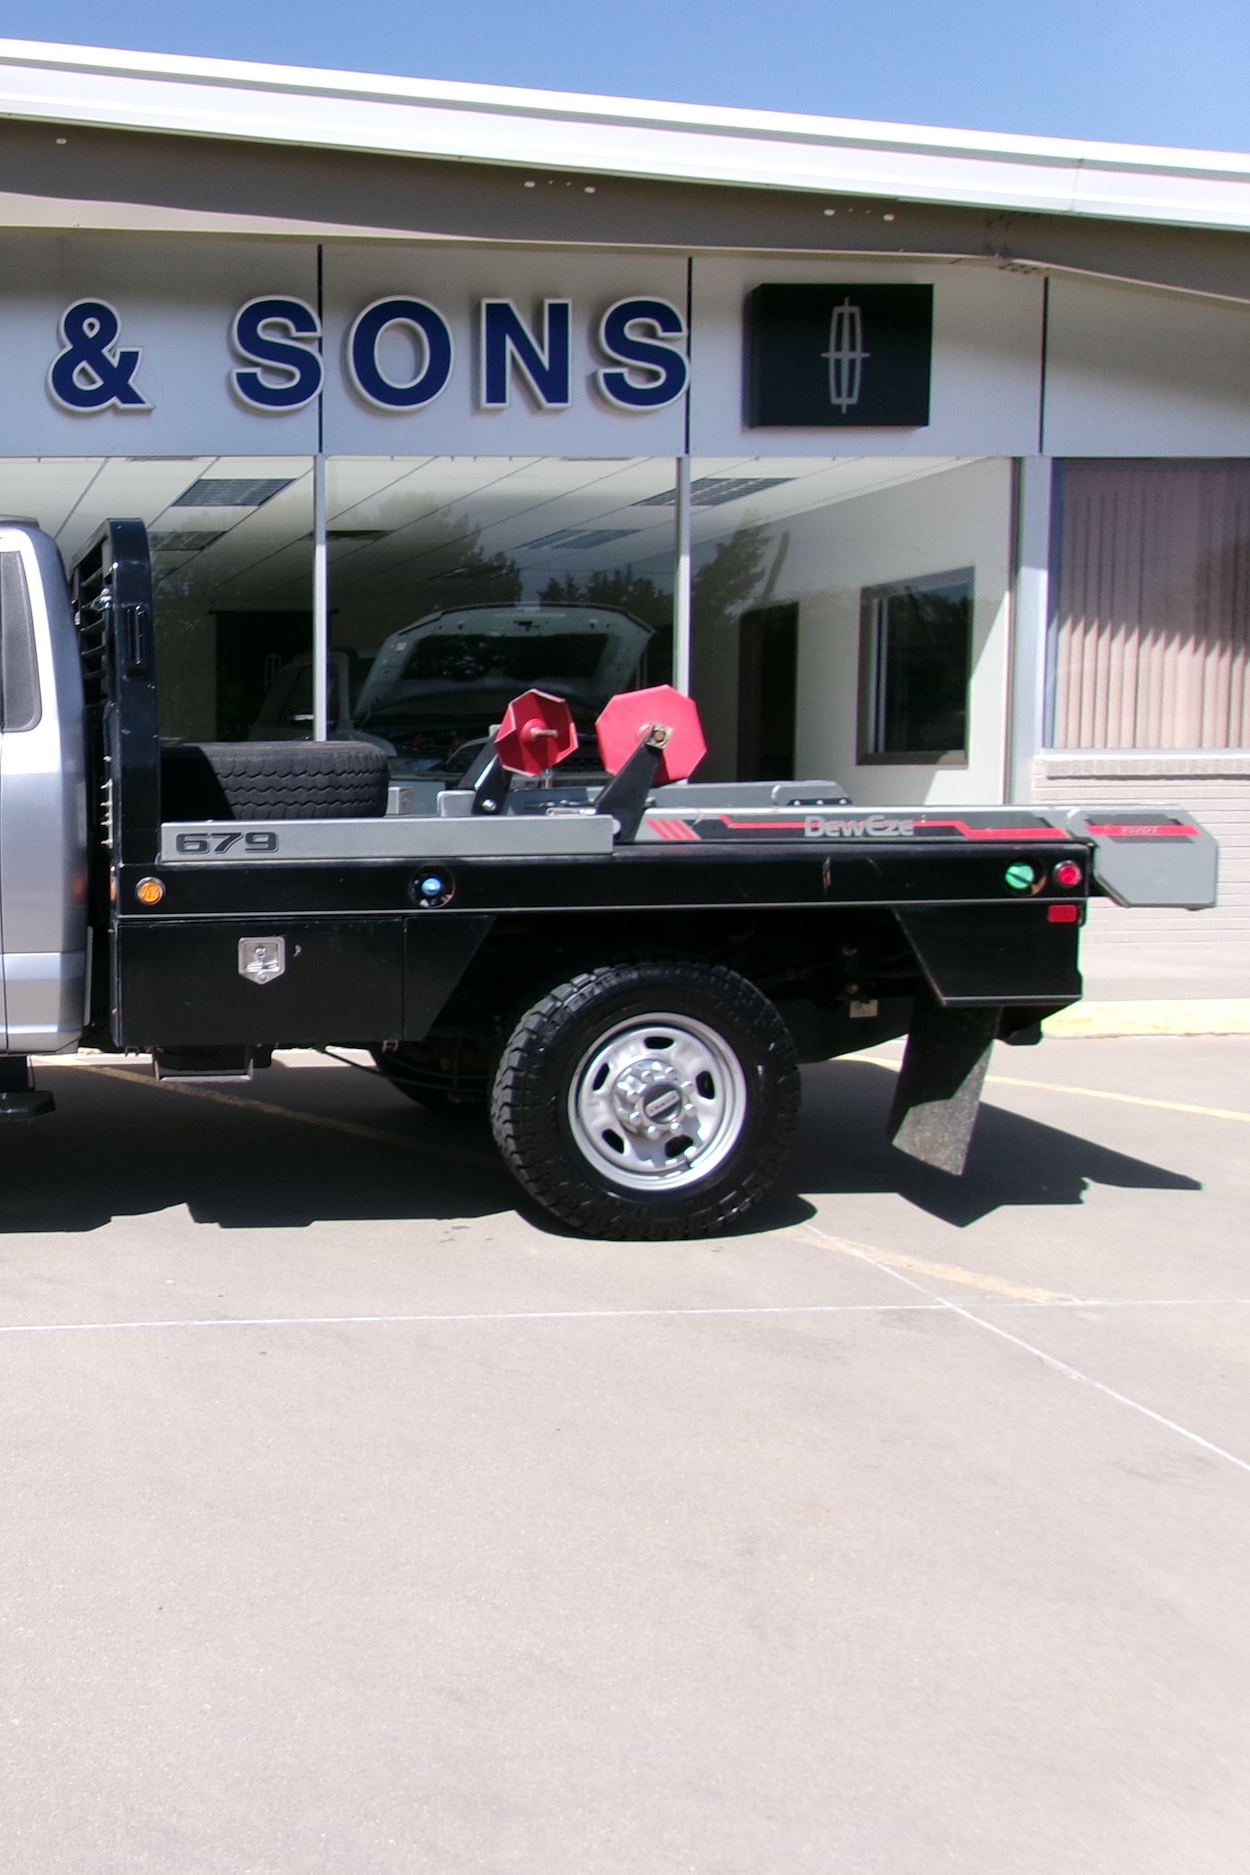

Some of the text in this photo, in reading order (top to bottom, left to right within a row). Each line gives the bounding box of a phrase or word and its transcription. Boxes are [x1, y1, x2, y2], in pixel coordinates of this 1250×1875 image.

[46, 298, 154, 412] &
[231, 294, 691, 412] SONS
[804, 815, 914, 837] DewEze
[175, 831, 279, 855] 679
